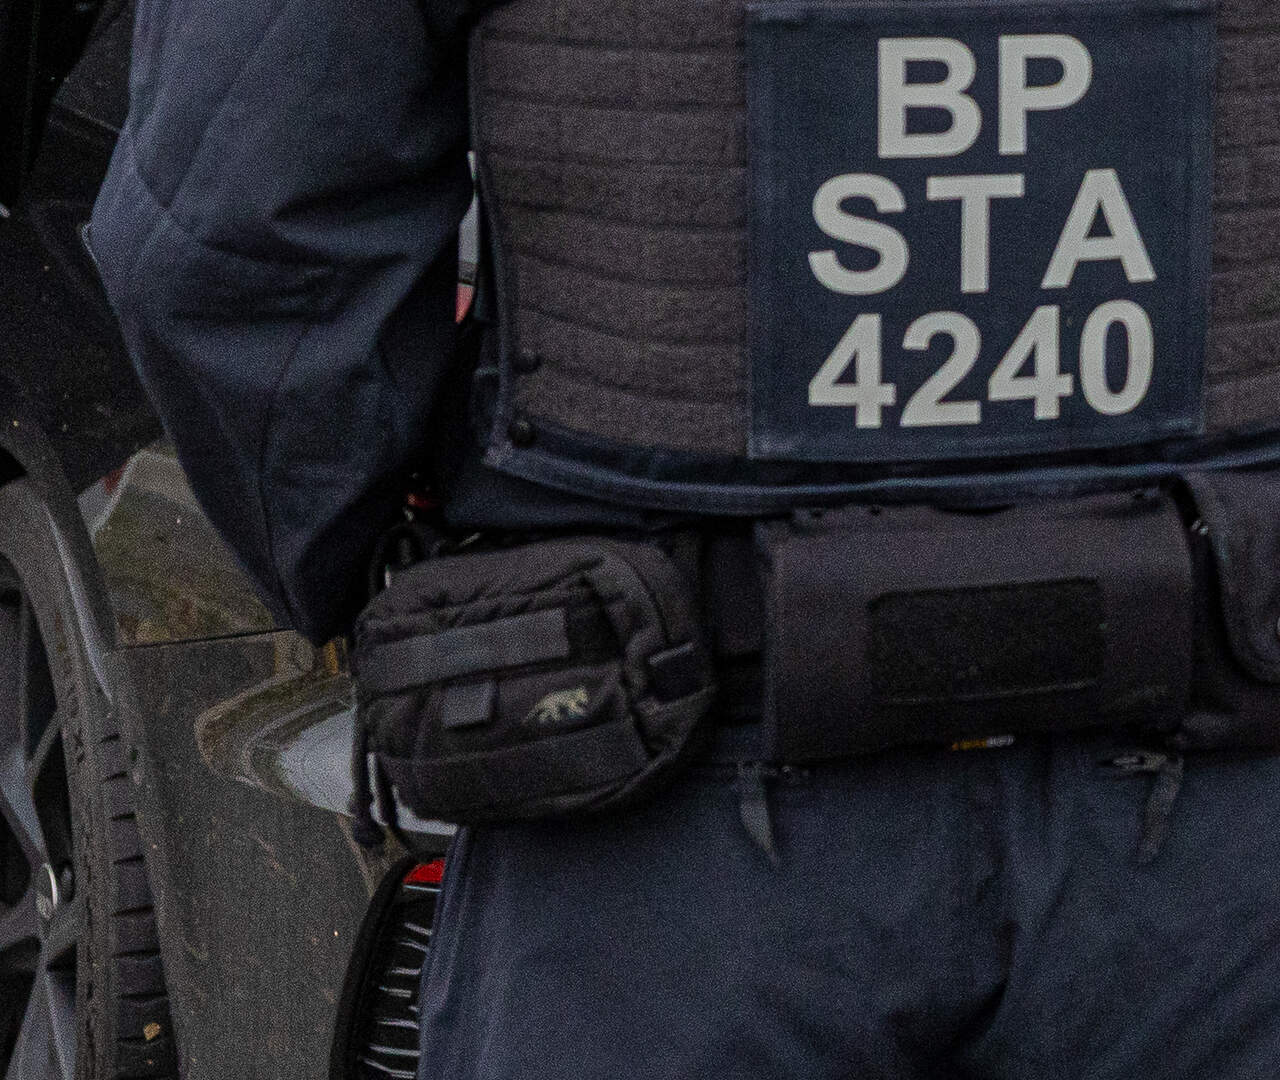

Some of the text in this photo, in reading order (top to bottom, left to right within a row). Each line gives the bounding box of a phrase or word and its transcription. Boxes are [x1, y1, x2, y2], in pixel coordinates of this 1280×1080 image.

[877, 34, 1092, 159] BP
[807, 168, 1157, 295] STA
[807, 299, 1155, 429] 4240
